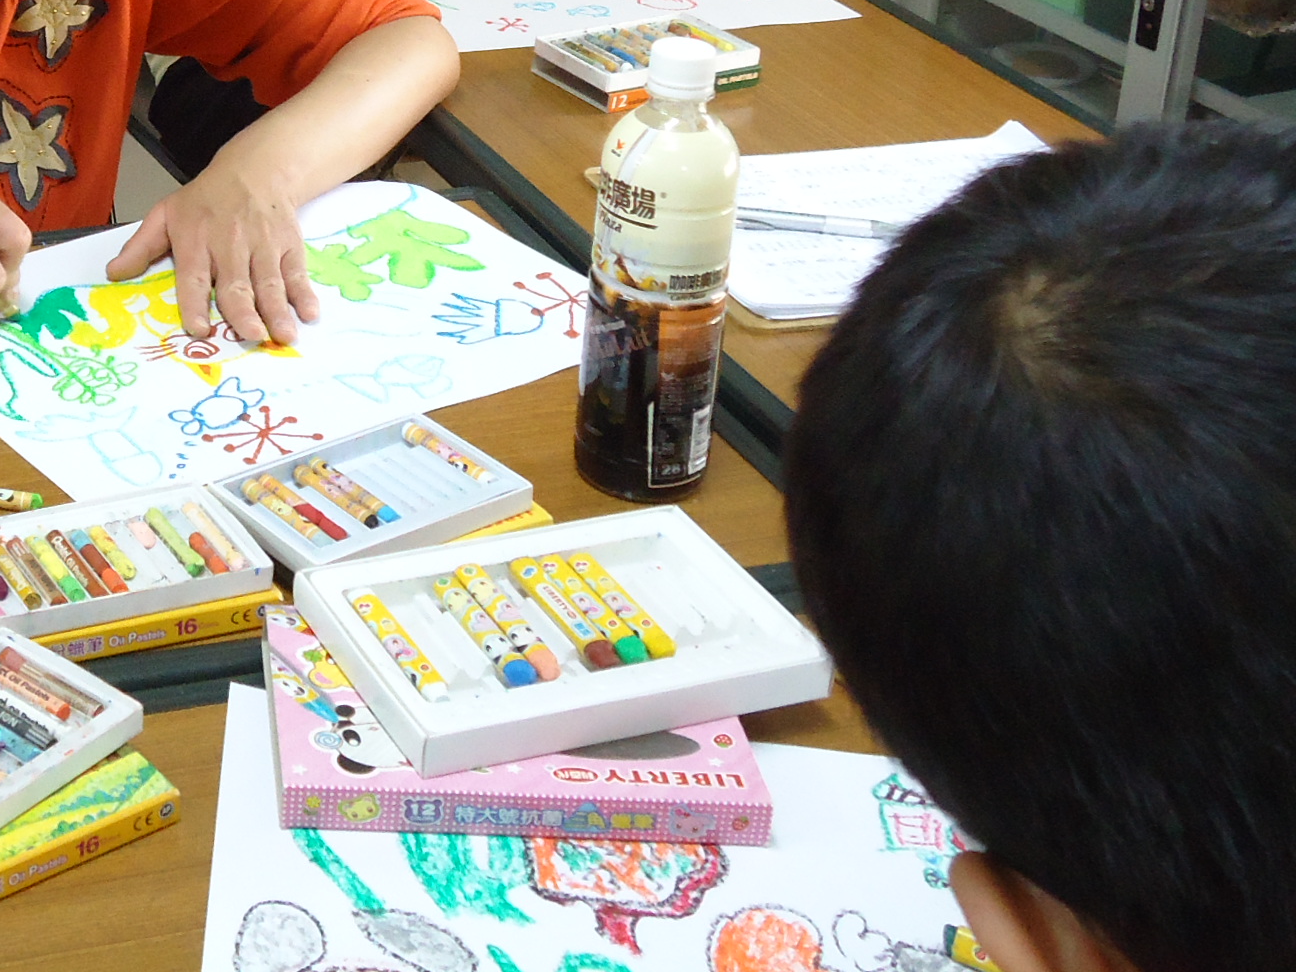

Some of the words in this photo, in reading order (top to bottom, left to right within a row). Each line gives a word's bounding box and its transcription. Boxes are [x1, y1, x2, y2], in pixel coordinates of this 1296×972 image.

[610, 94, 628, 109] 12
[600, 171, 657, 220] 啡廣場
[108, 634, 126, 648] Oil
[128, 629, 167, 645] Pastels
[174, 618, 198, 636] 16
[20, 679, 50, 702] Pastels
[605, 767, 746, 788] LIBERTY
[409, 803, 436, 818] 12
[8, 871, 26, 886] Oil
[28, 855, 69, 877] Pastels
[75, 835, 100, 858] 16
